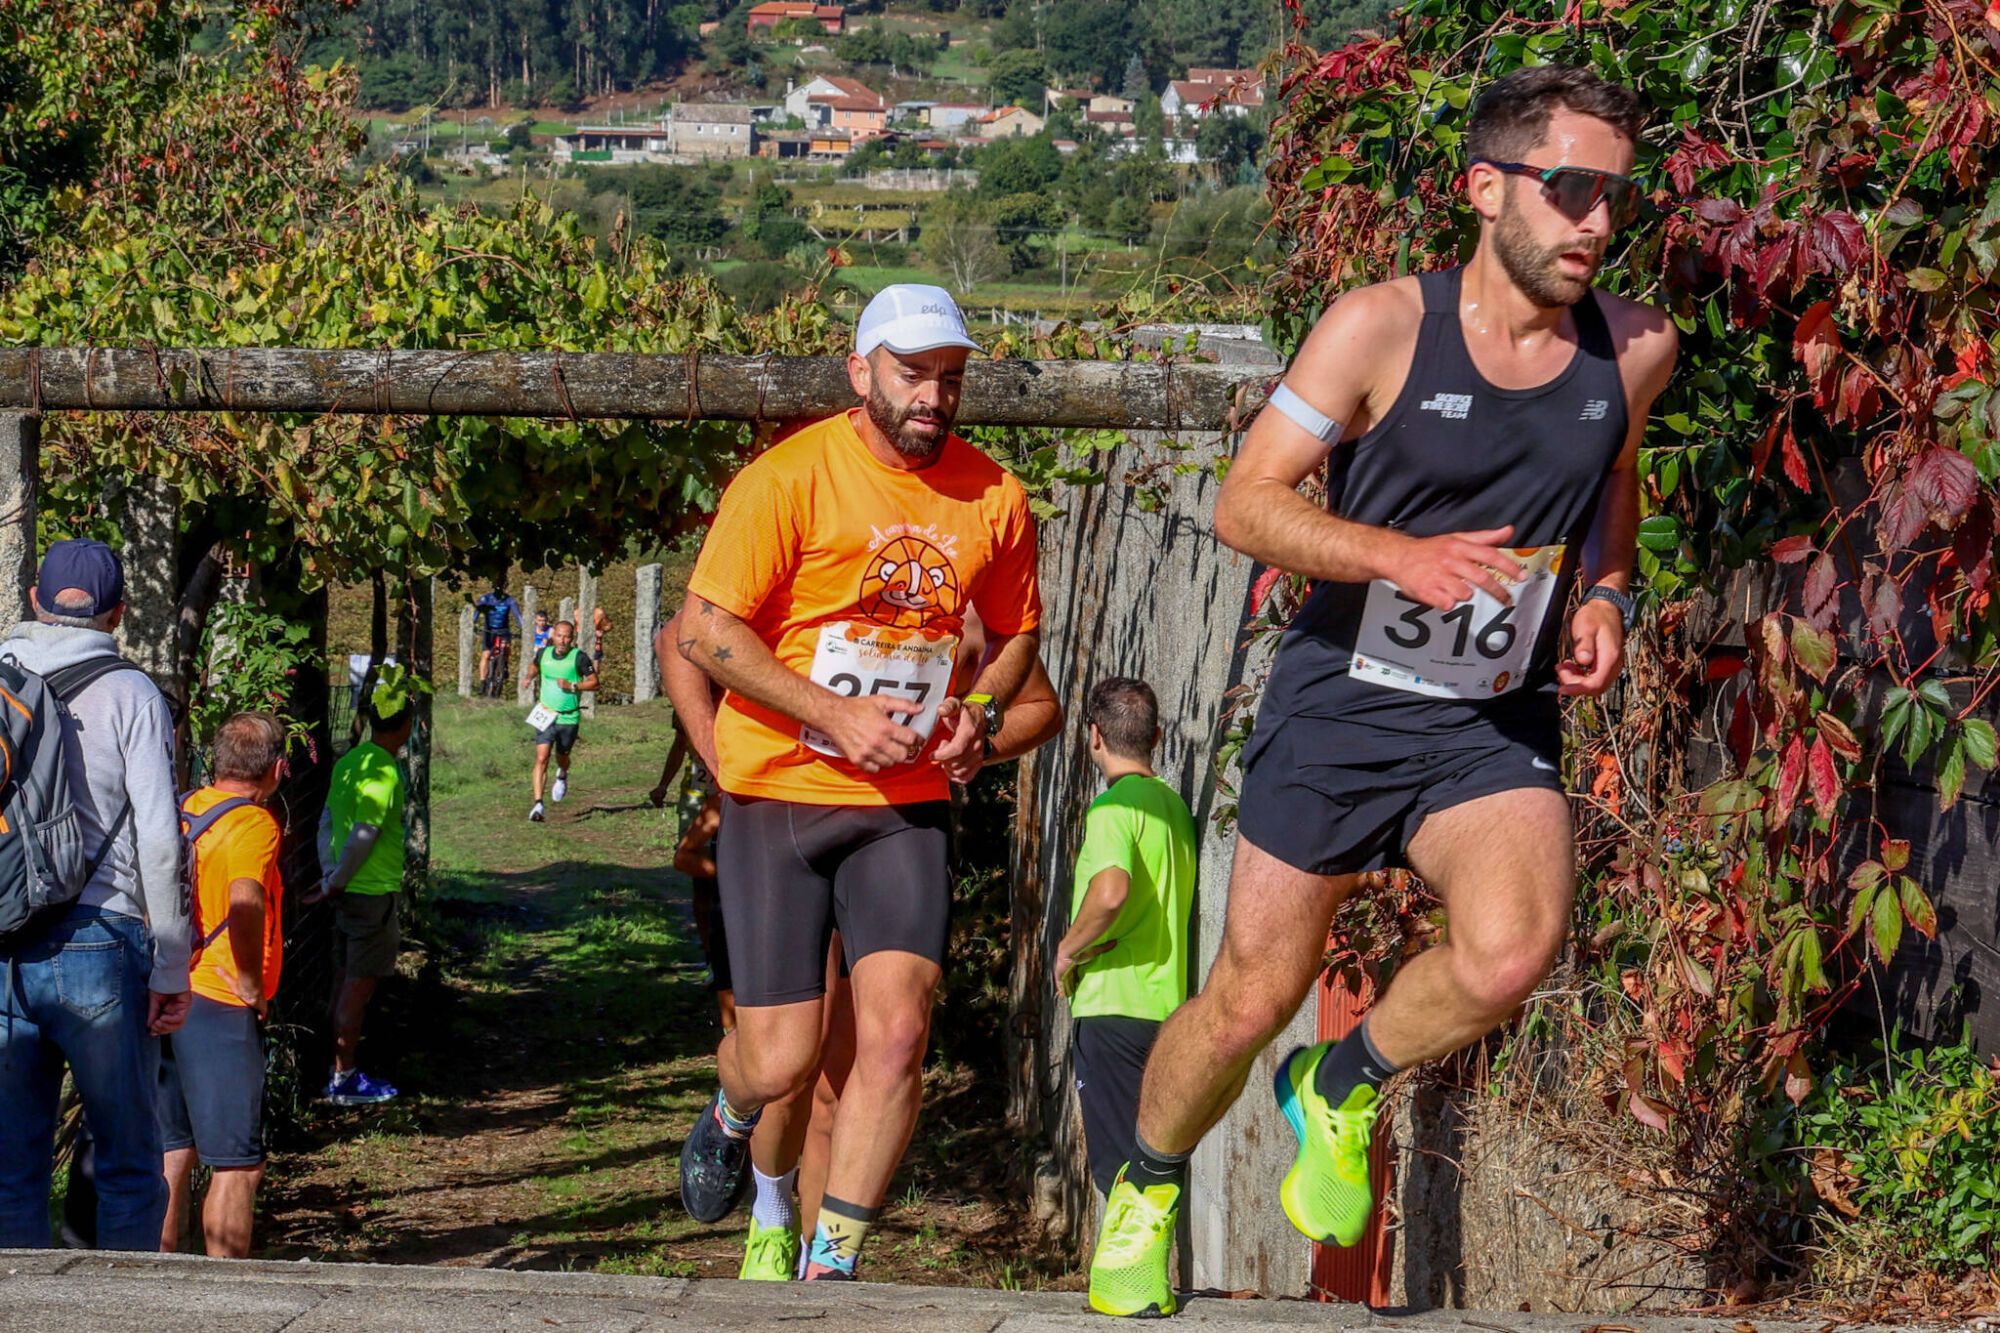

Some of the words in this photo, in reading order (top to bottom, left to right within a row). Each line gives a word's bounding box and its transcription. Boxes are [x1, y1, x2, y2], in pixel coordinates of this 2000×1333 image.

[921, 303, 947, 316] edp
[1384, 590, 1517, 660] 316
[860, 638, 896, 650] CARREIRA
